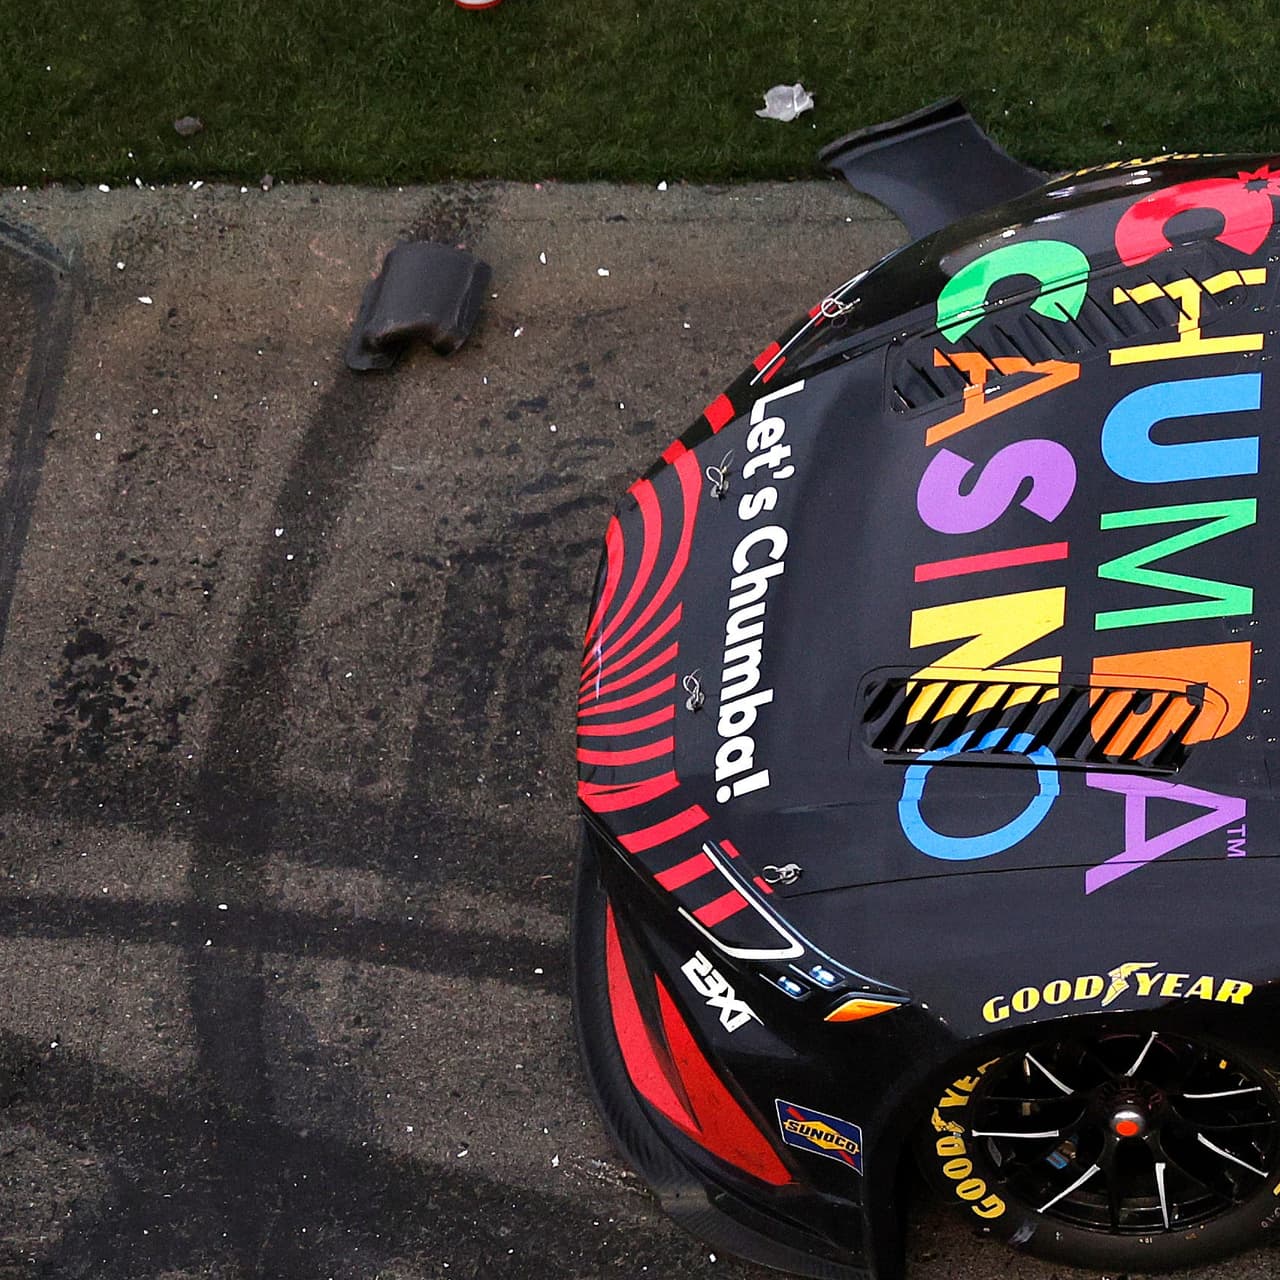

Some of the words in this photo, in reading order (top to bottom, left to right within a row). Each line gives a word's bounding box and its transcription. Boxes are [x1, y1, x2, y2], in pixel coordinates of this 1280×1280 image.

[738, 379, 804, 521] Let's
[899, 240, 1091, 861] CASINO
[713, 524, 790, 805] Chumba!
[981, 962, 1254, 1024] GOODYEAR
[783, 1116, 860, 1156] SUNOCO
[930, 1056, 1007, 1220] GOODYE
